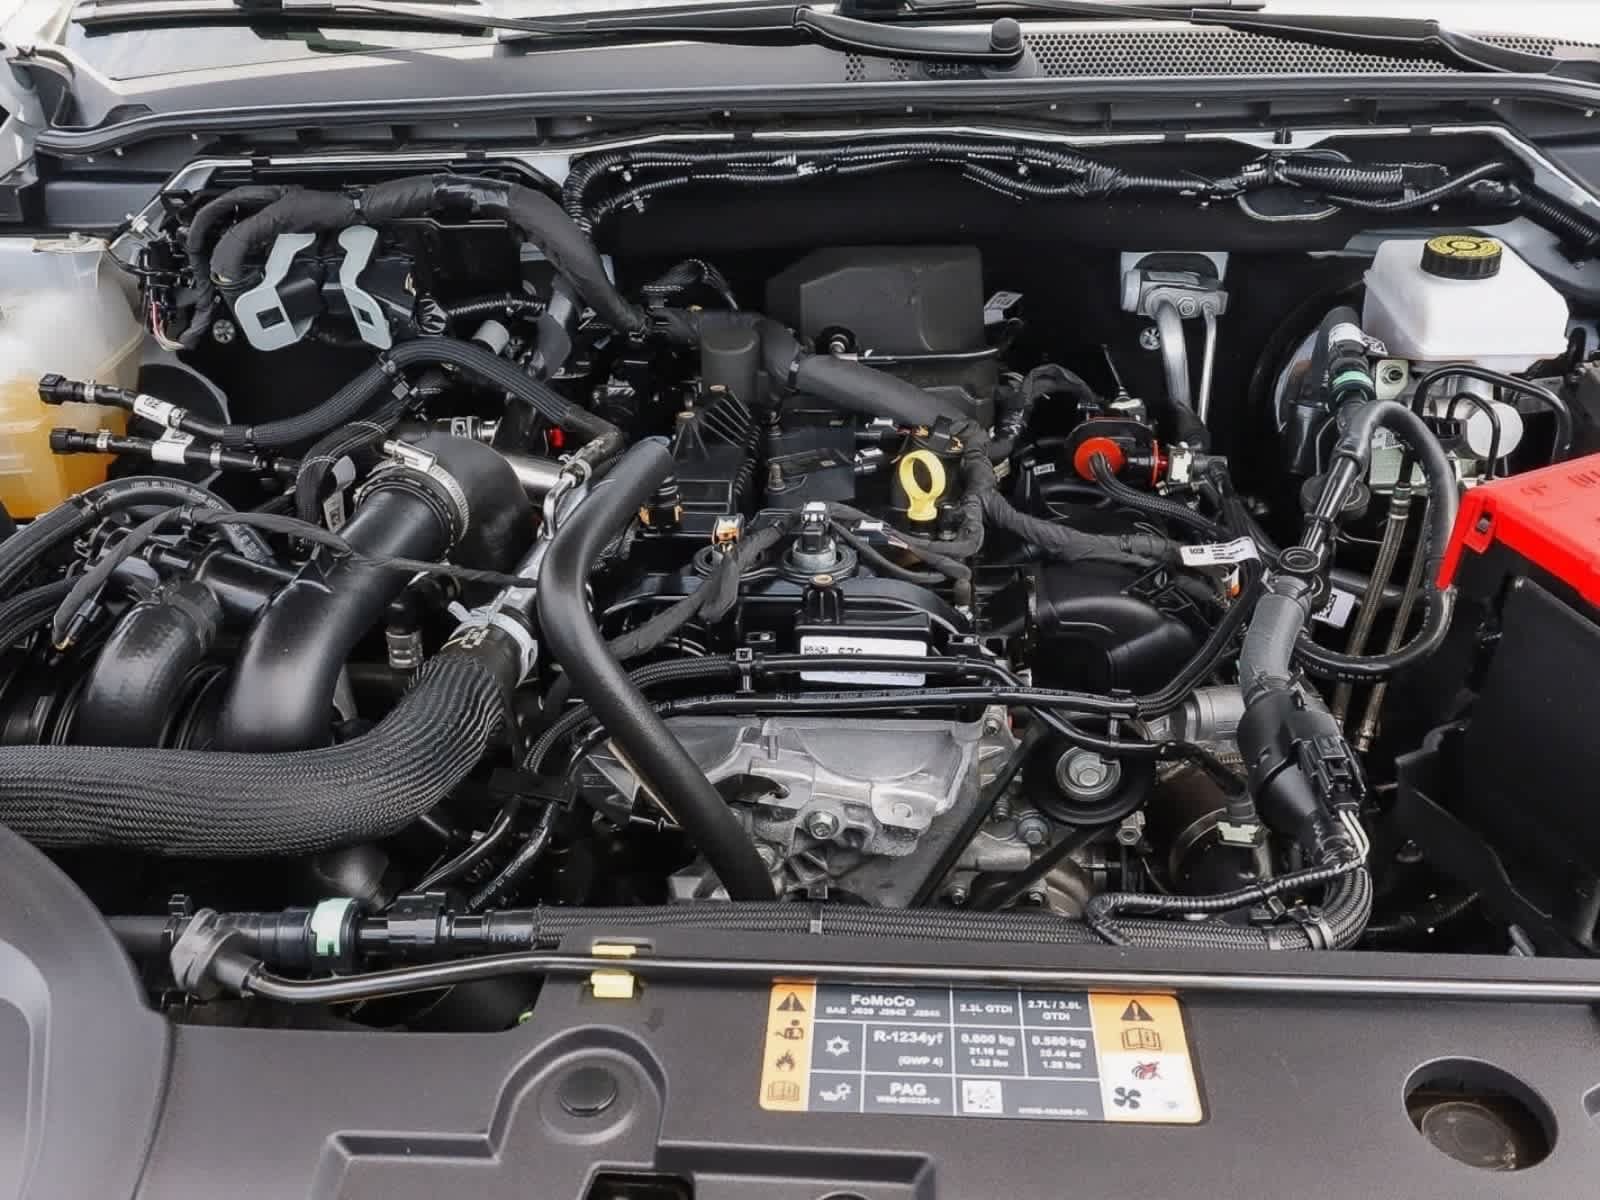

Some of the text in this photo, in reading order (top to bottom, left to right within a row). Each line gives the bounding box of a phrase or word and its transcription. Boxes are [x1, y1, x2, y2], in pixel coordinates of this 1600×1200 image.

[851, 994, 916, 1007] FoMoCo
[985, 1004, 1013, 1014] GTDI
[1042, 1011, 1071, 1021] GTDI
[874, 1030, 944, 1047] R-1234yf
[998, 1034, 1016, 1047] kg
[1069, 1037, 1087, 1049] kg
[890, 1081, 928, 1097] PAG
